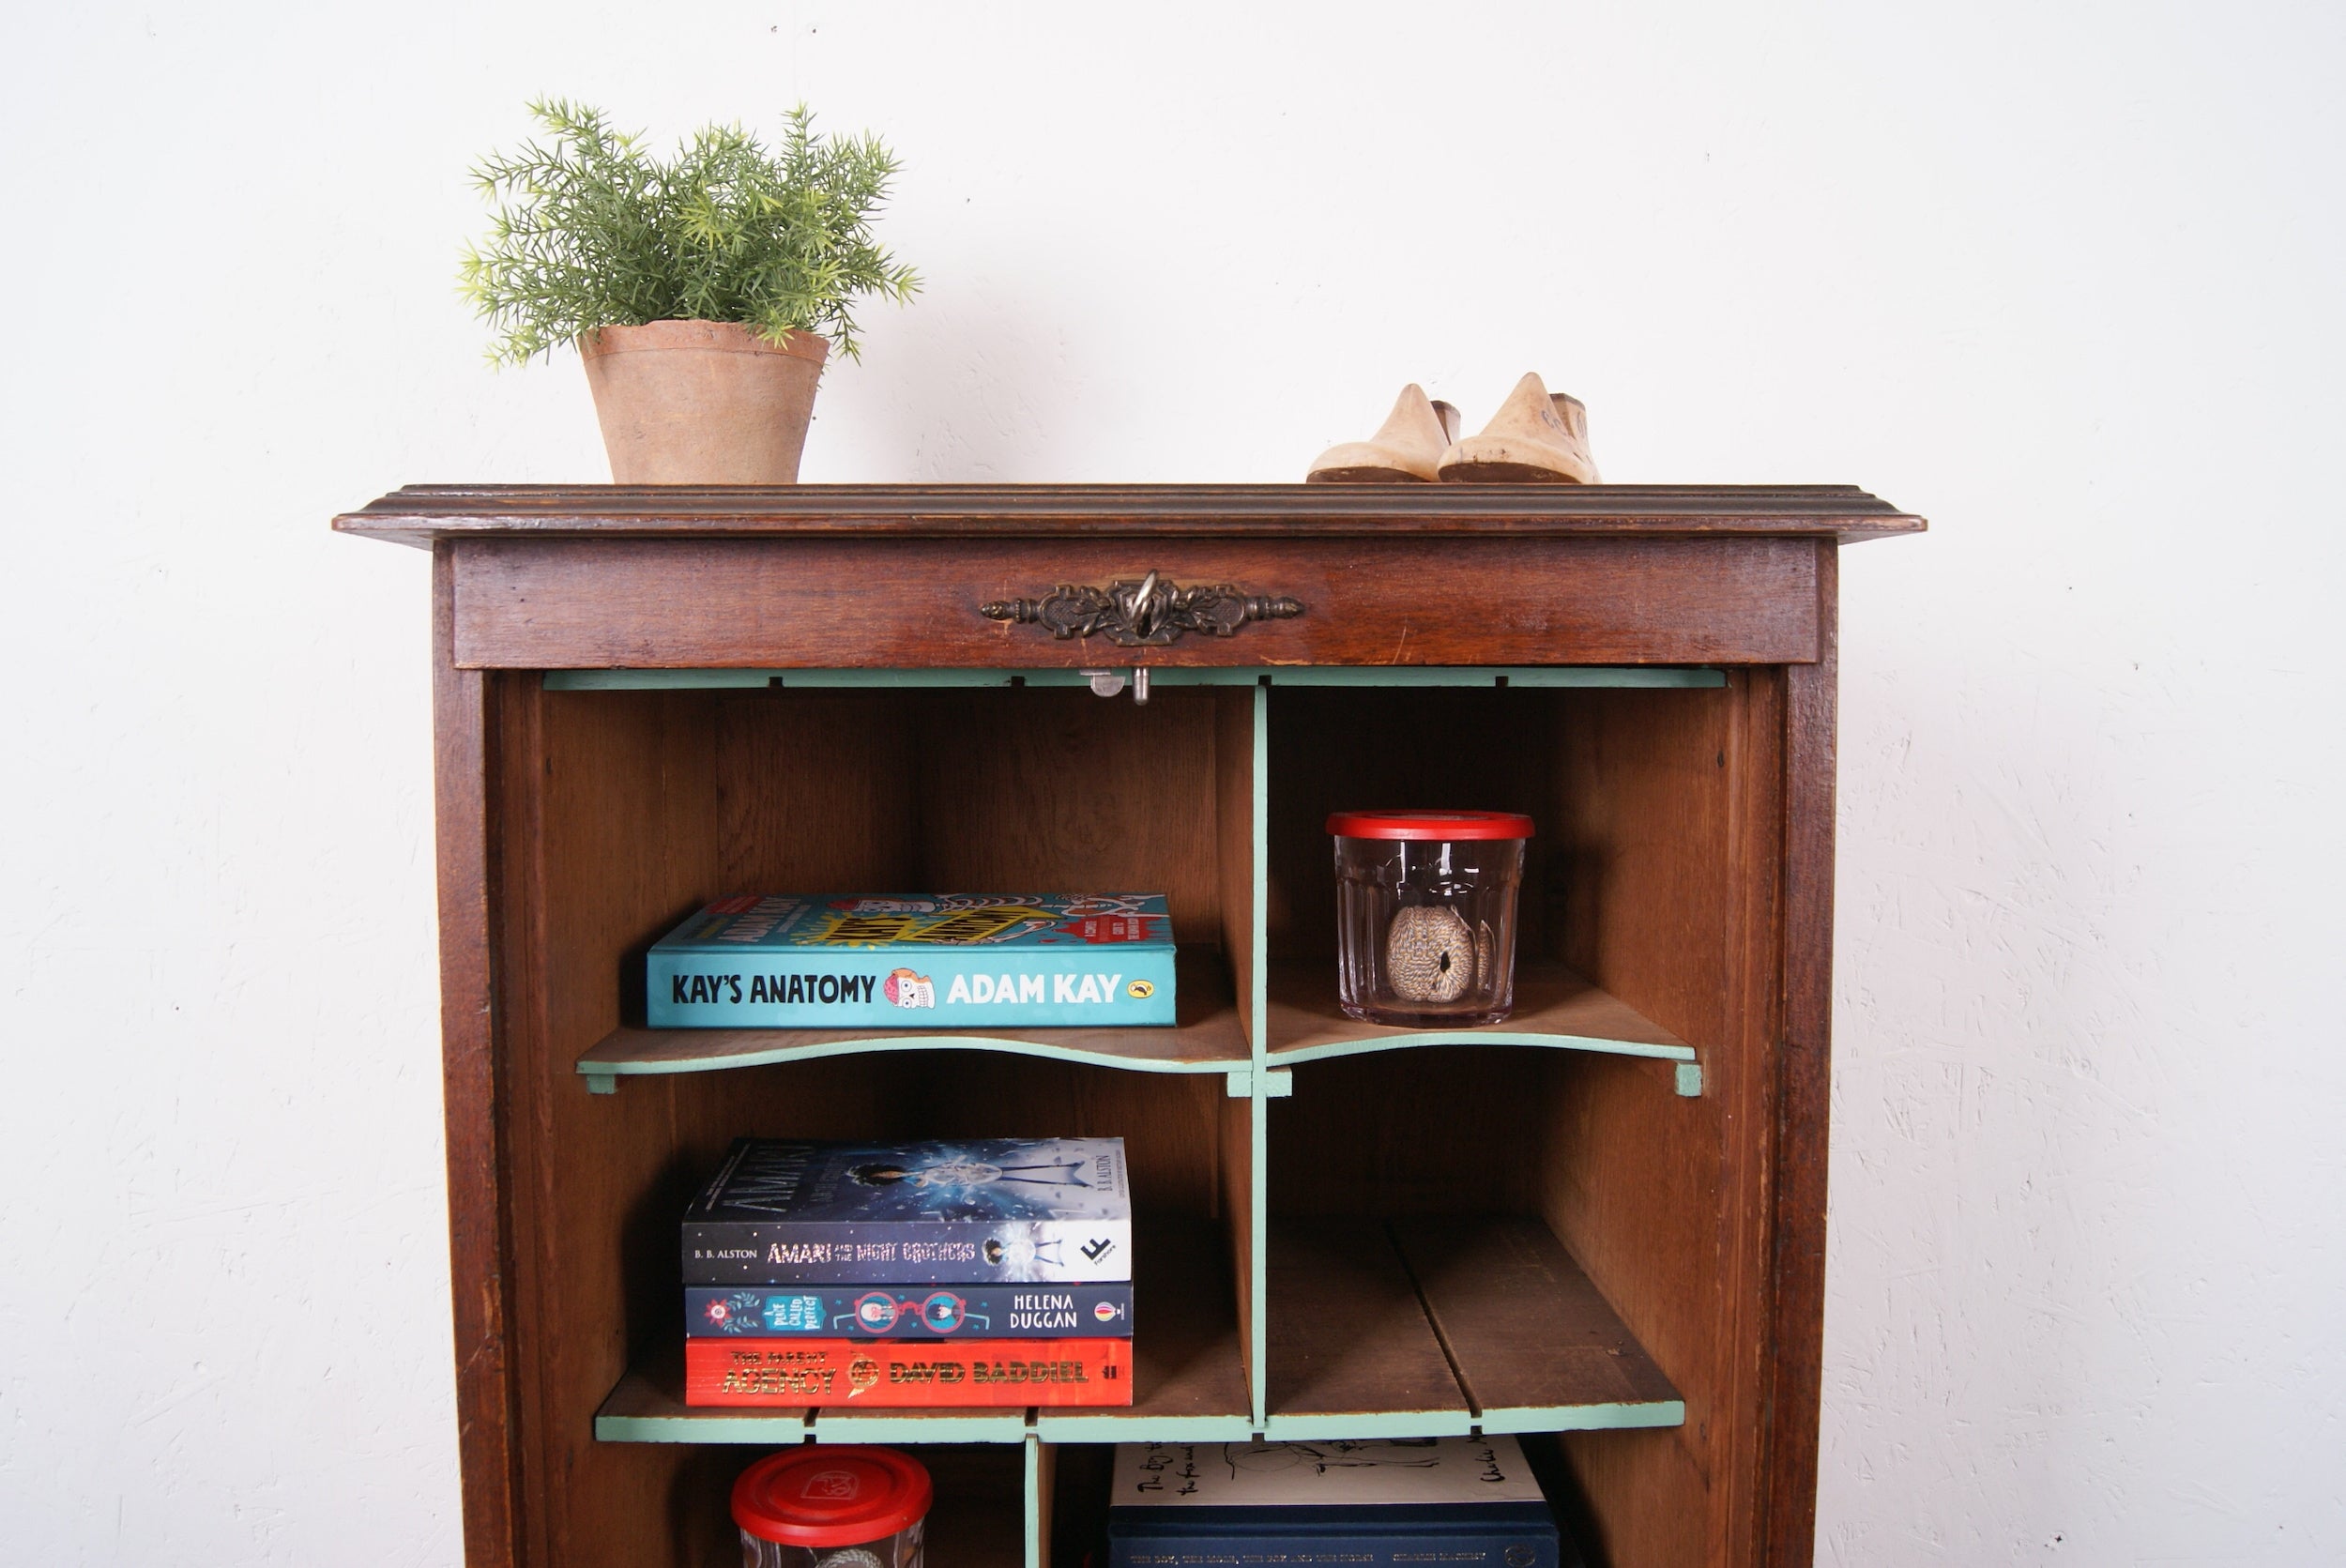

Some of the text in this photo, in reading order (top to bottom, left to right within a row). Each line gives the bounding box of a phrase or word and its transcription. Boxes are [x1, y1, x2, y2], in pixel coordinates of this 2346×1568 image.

[672, 974, 1122, 1004] KAY'S ANATOMY ADAM KAY
[694, 1249, 757, 1258] B. B. ALSTON
[767, 1242, 832, 1264] AMARI
[857, 1242, 898, 1262] NIGHT
[788, 1299, 803, 1326] CALLED
[803, 1295, 820, 1330] PERFECT
[1014, 1294, 1074, 1310] HELENA
[1010, 1312, 1077, 1329] DUGGAN
[731, 1350, 829, 1365] THE PARENT
[722, 1368, 837, 1395] AGENCY
[890, 1361, 1089, 1384] DAVID BADDIEL
